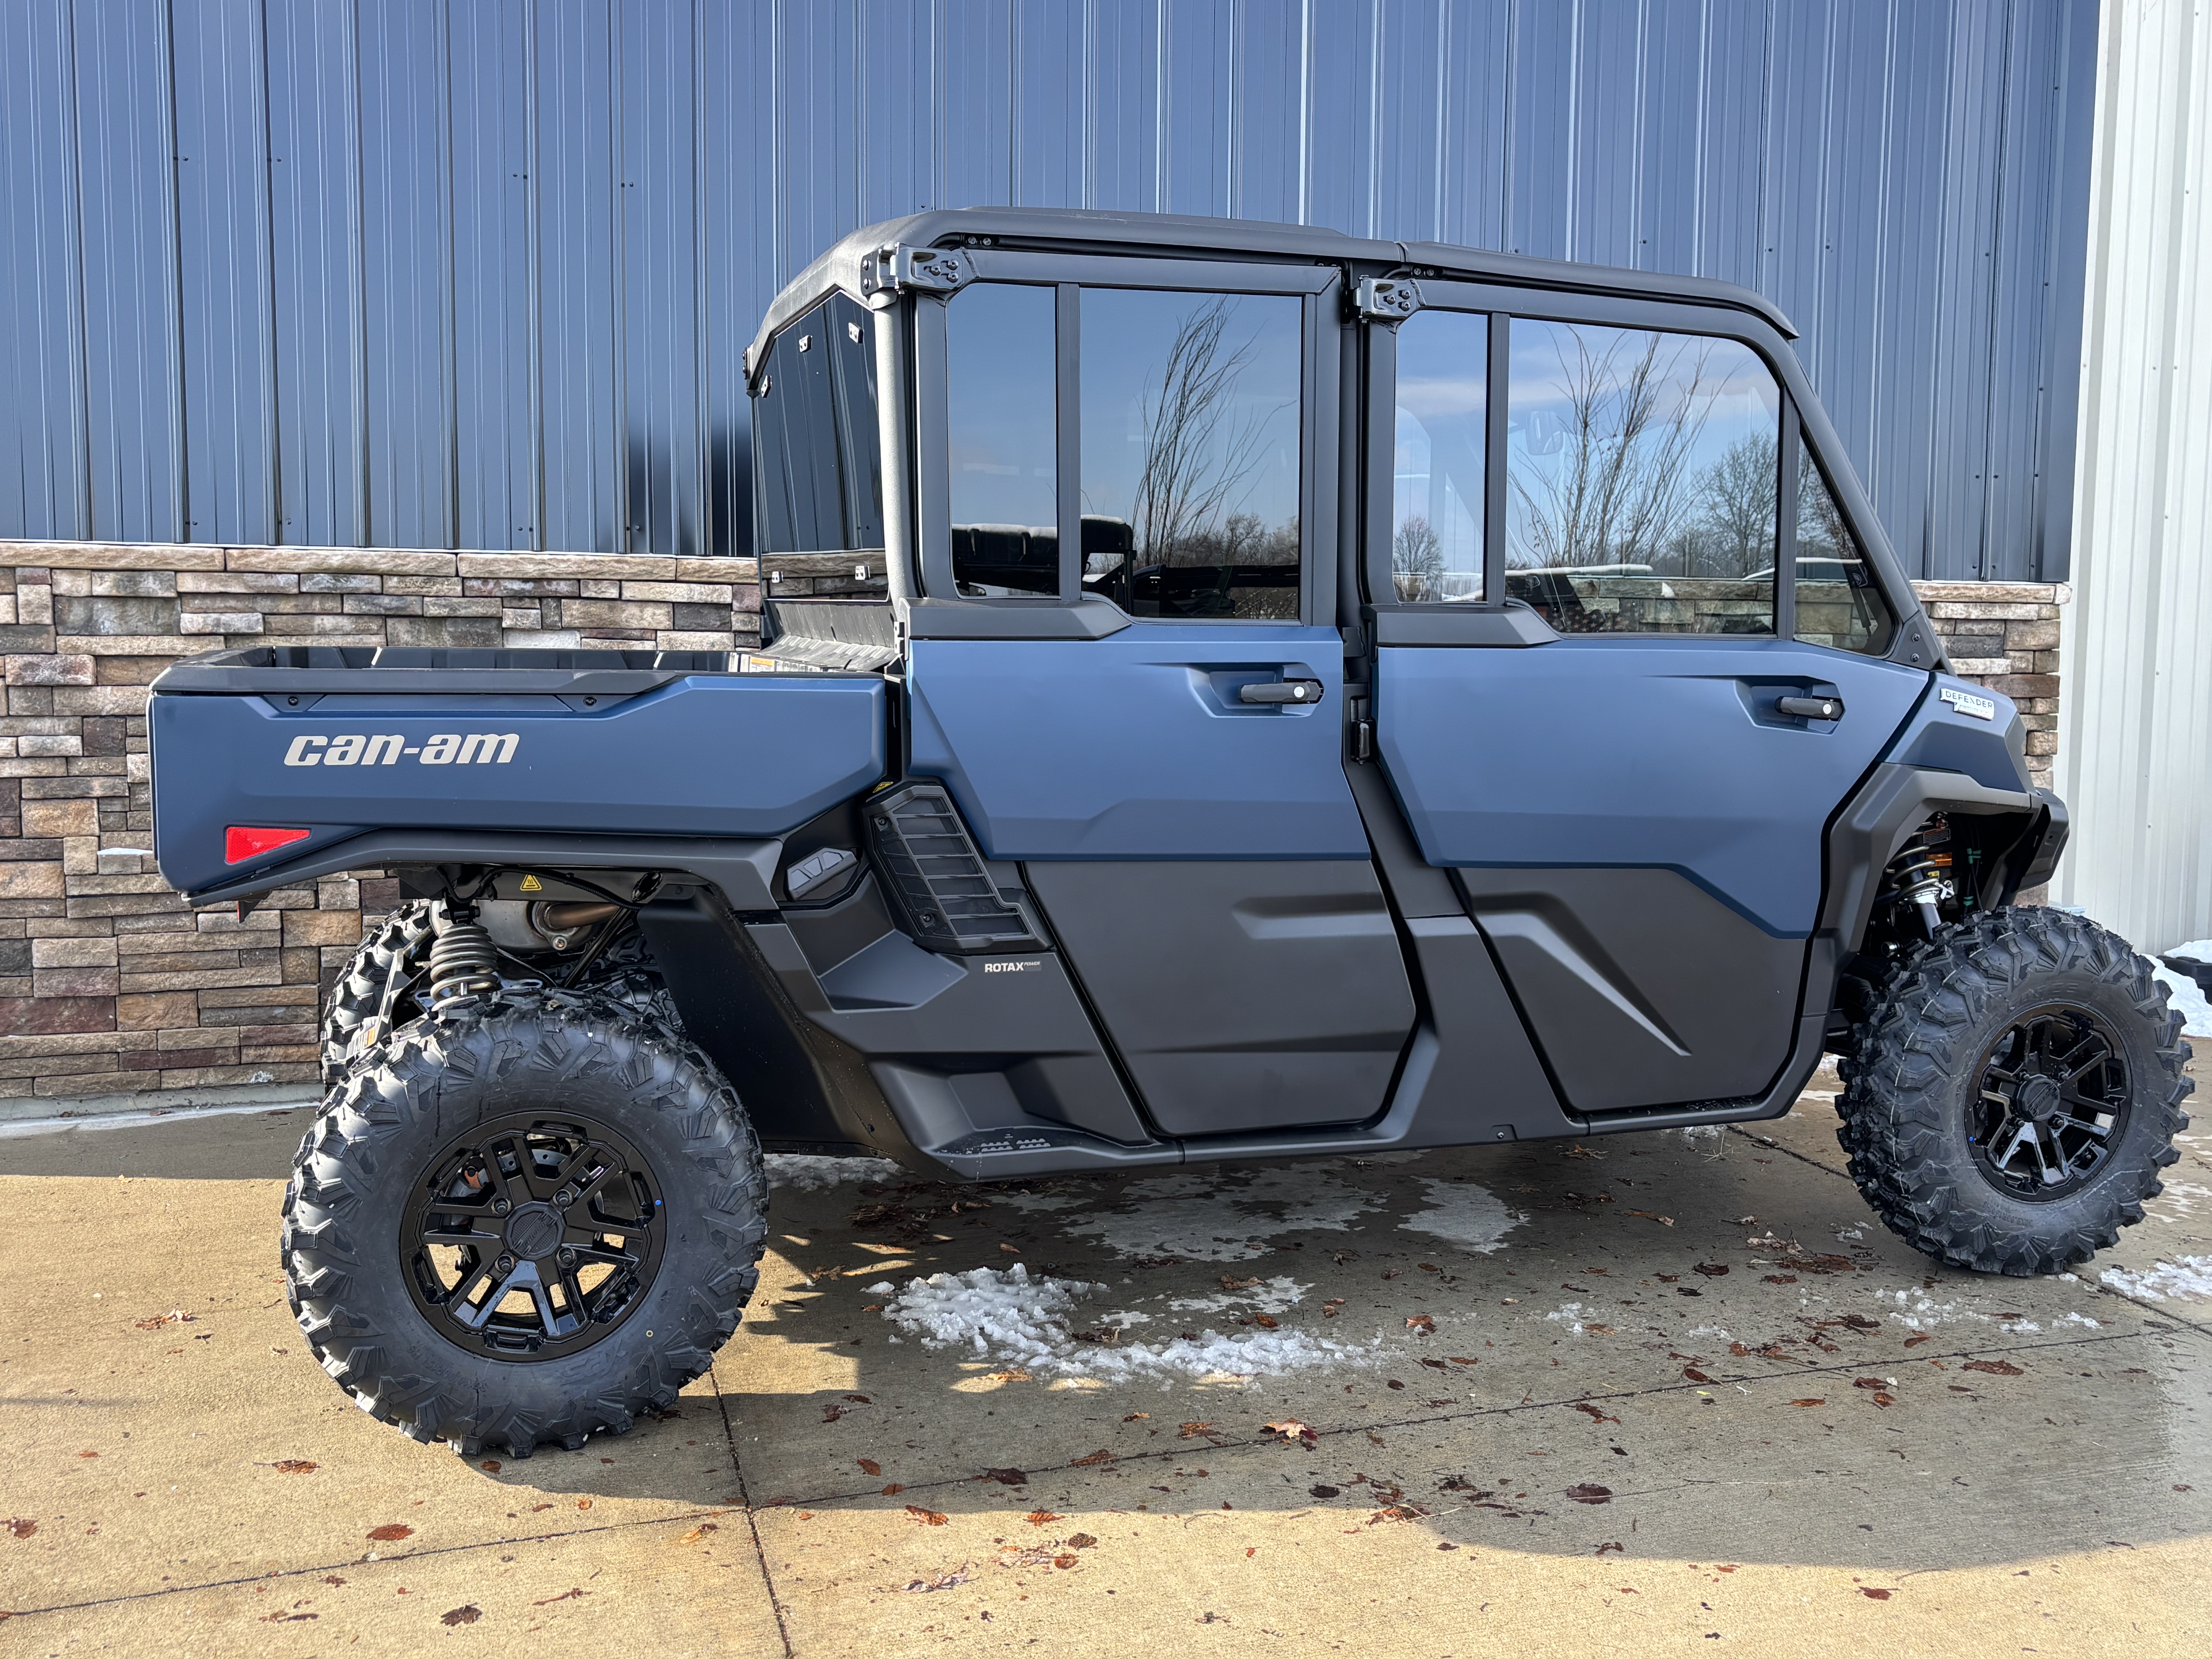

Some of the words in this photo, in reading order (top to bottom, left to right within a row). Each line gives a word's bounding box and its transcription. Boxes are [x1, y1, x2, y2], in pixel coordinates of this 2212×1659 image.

[1946, 690, 1992, 708] DEFENDER
[284, 733, 519, 766] can-am
[984, 962, 1024, 973] ROTAX
